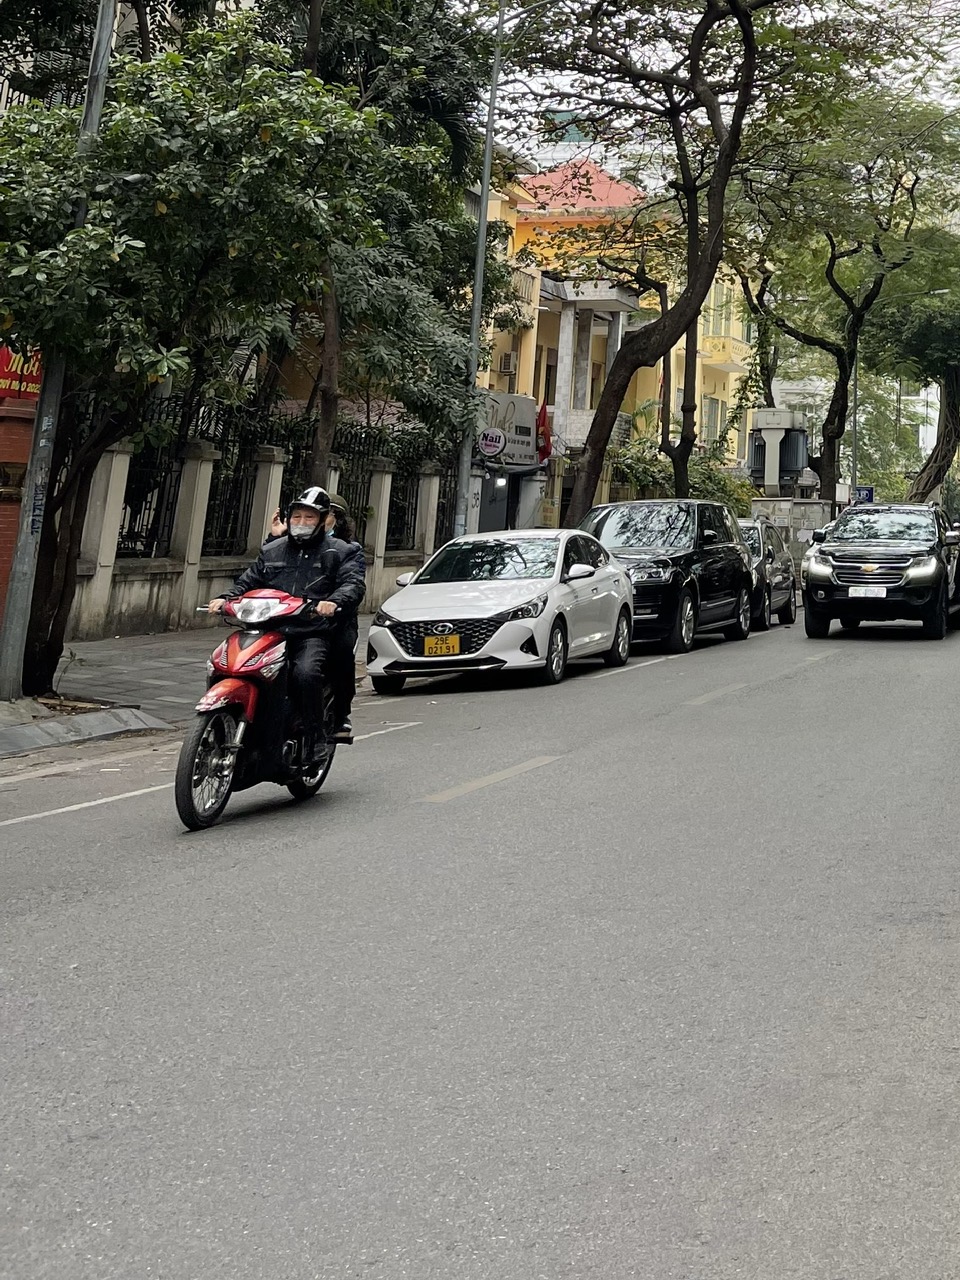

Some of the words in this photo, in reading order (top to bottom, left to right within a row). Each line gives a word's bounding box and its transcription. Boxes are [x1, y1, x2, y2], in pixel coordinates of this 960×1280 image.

[482, 432, 502, 444] Nail
[434, 636, 450, 645] 29E
[428, 645, 455, 654] 021.91
